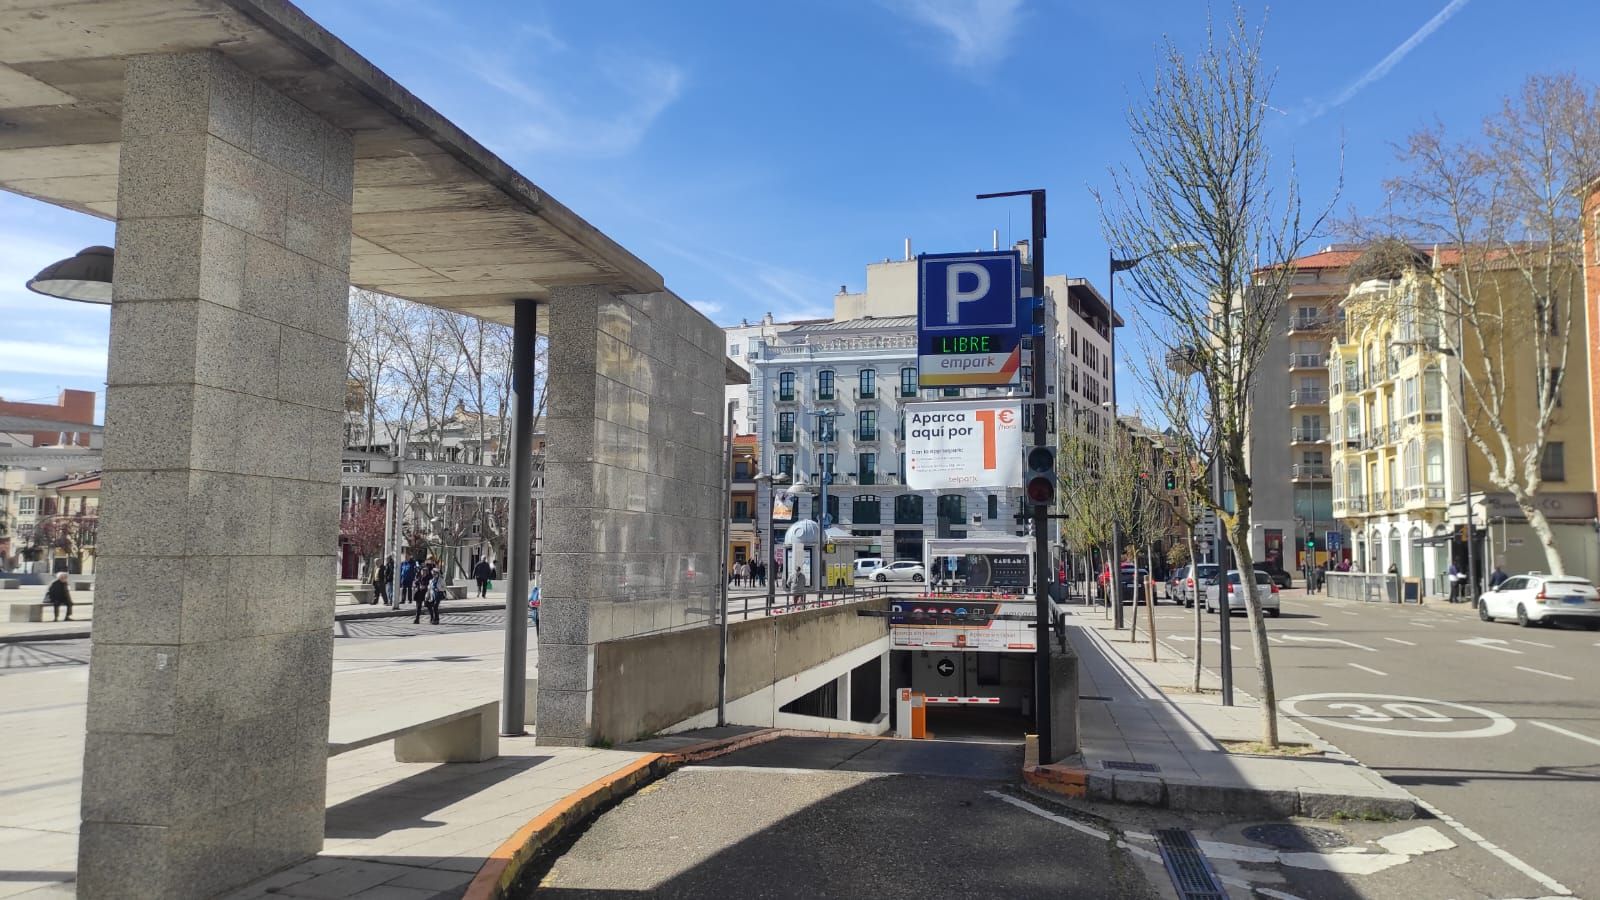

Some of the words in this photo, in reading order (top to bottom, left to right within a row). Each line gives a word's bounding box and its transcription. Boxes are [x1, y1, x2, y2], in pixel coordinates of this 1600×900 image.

[946, 262, 991, 324] P
[942, 336, 991, 353] LIBRE
[940, 355, 995, 370] empark
[912, 413, 965, 426] Aparca
[911, 426, 945, 440] aquí
[948, 427, 973, 439] por
[948, 475, 978, 484] telpark
[1328, 702, 1454, 723] 30
